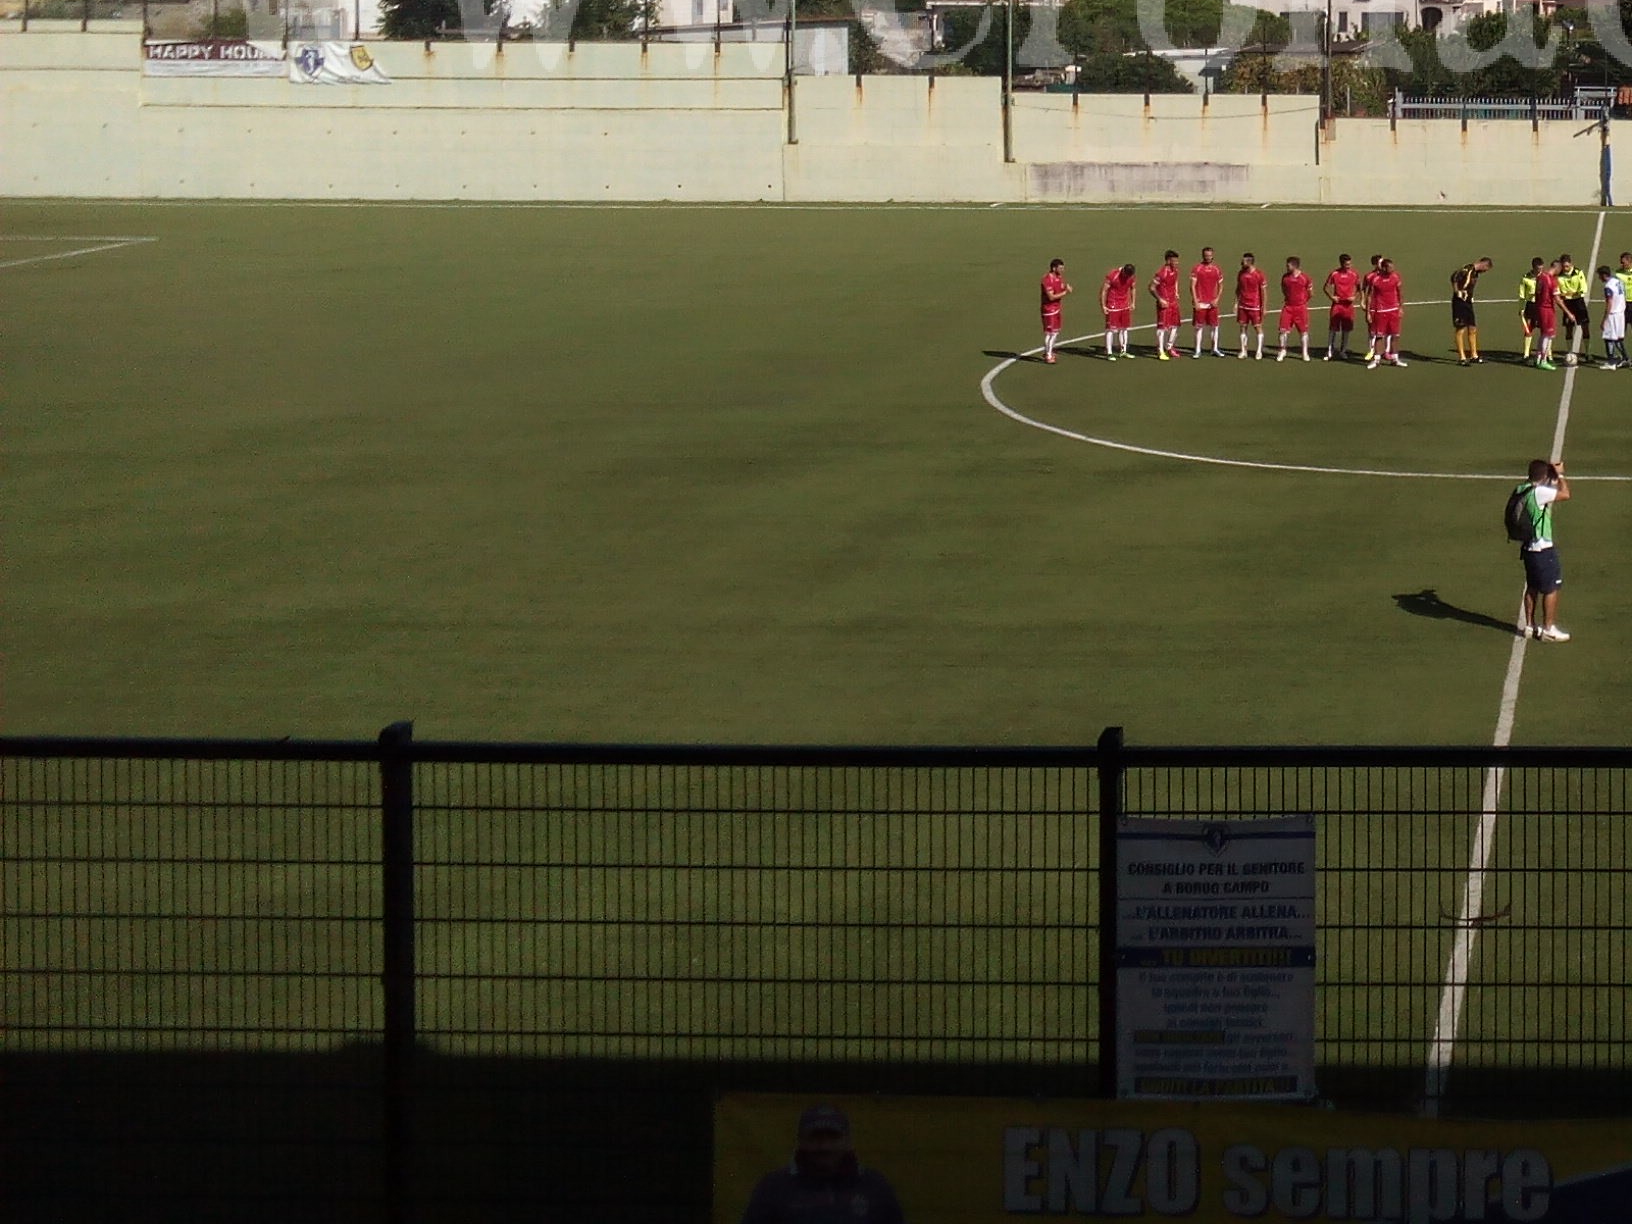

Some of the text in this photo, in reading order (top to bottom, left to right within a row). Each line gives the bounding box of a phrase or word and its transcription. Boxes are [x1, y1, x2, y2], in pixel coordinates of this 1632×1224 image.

[149, 45, 214, 60] HAPPY
[1127, 861, 1305, 876] CONSIGLIO PER IL GENITORE
[1162, 882, 1172, 894] A
[1223, 880, 1270, 894] CAMPO
[1004, 1126, 1553, 1223] ENZO sempre
